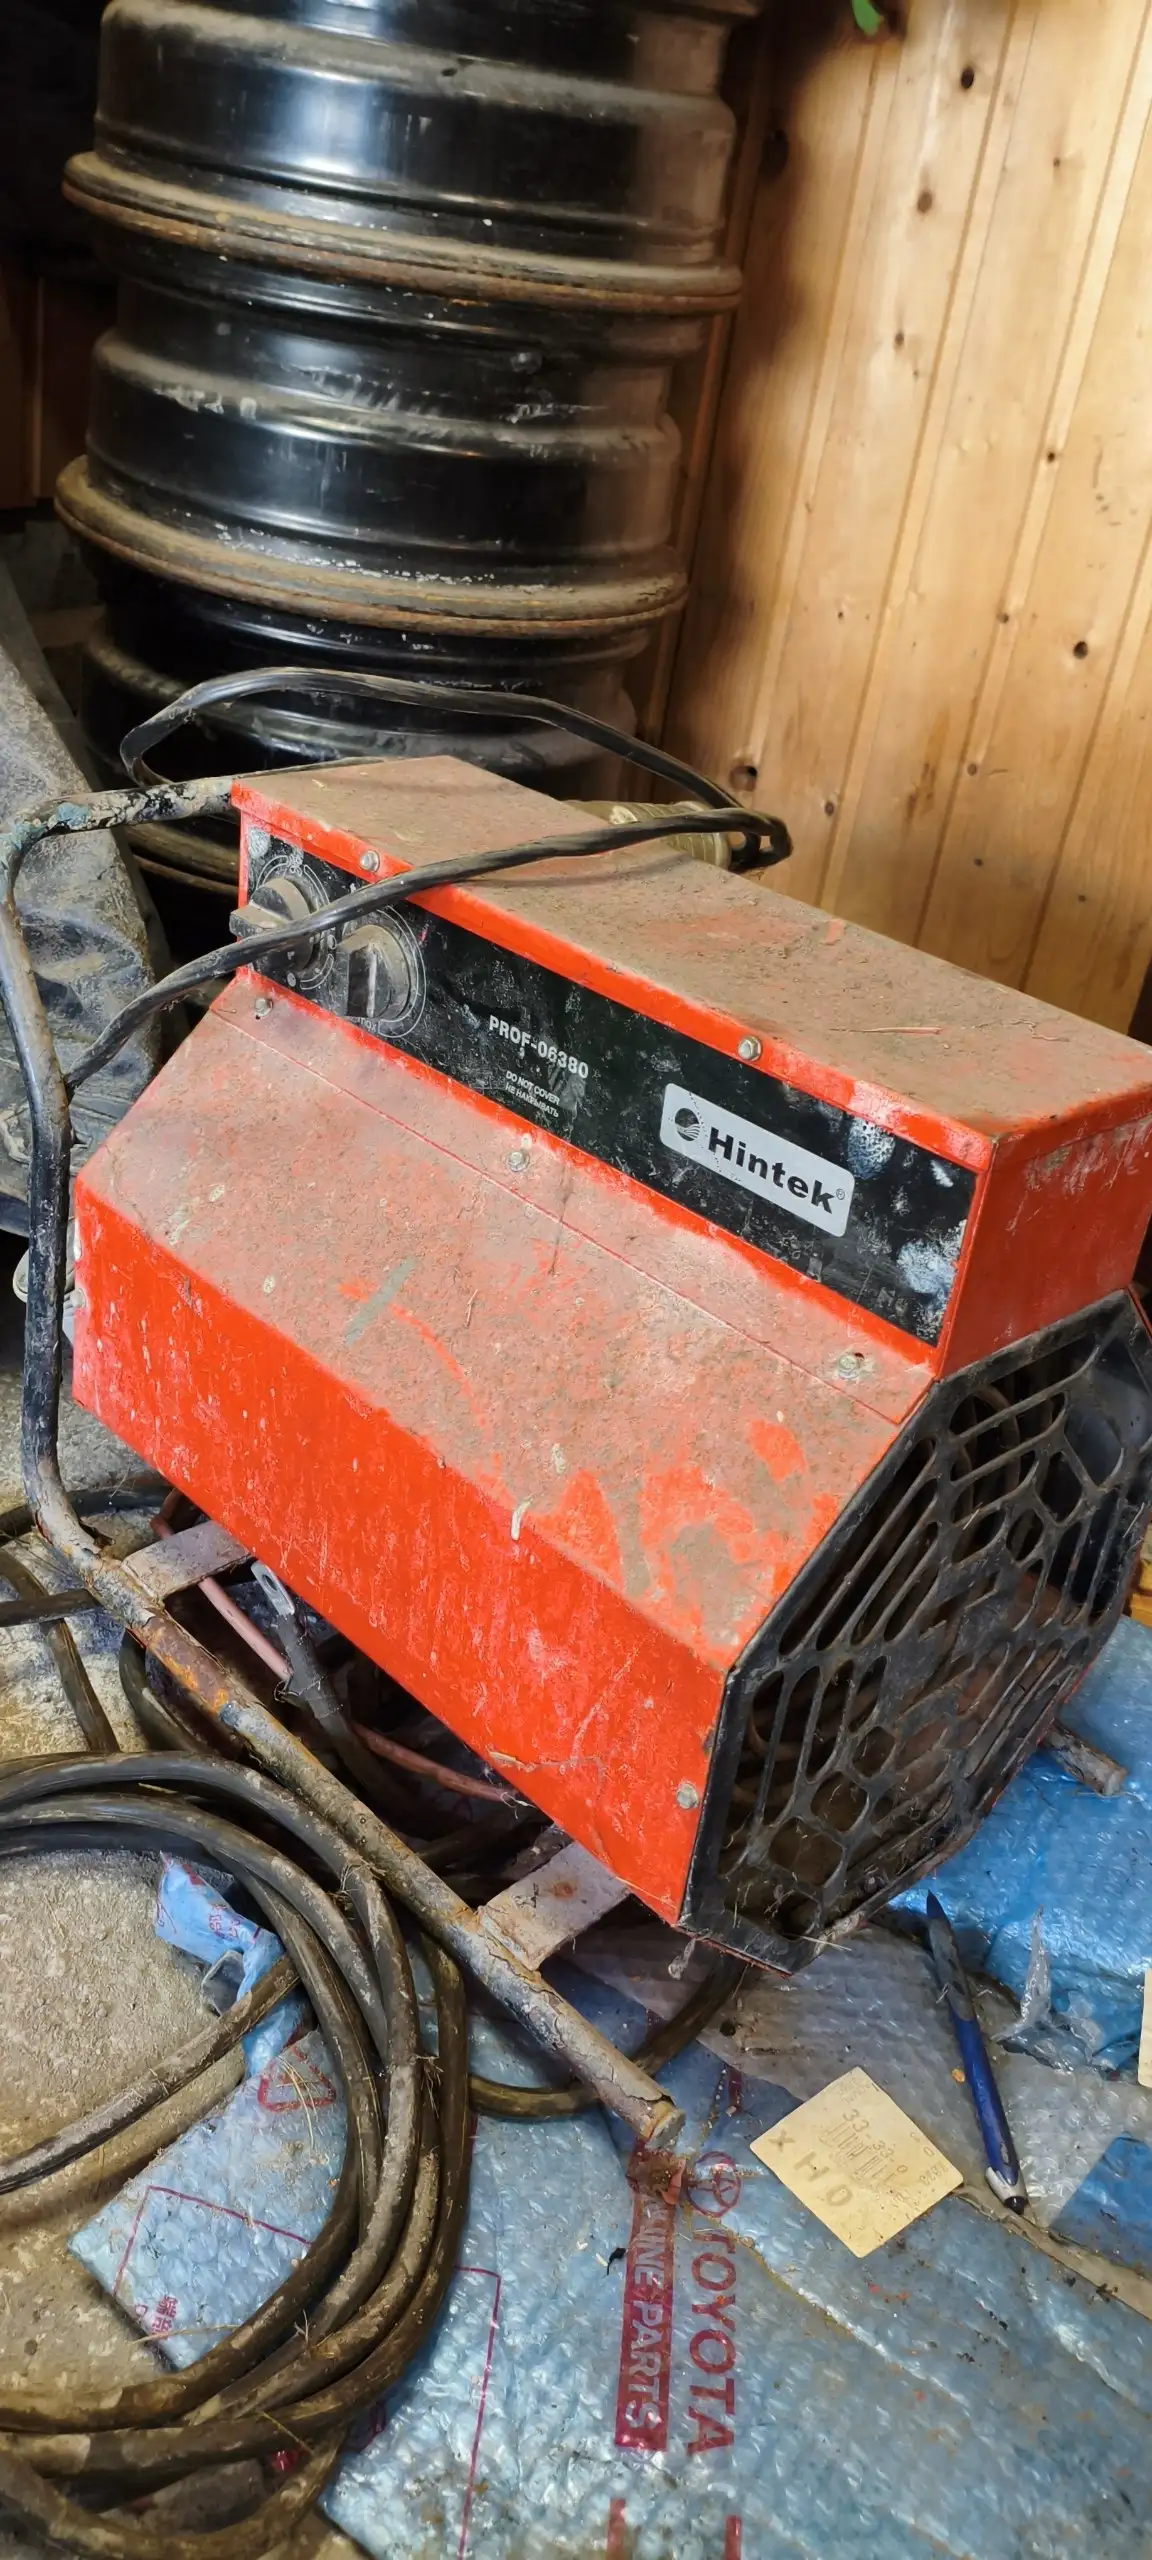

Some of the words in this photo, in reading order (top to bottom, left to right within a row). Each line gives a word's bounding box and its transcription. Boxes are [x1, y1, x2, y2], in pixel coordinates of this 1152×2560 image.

[489, 1015, 588, 1078] PROF-06380
[506, 1070, 517, 1082] DO
[518, 1077, 534, 1091] NOT
[534, 1087, 560, 1105] COVER
[708, 1126, 834, 1215] Hintek
[625, 2300, 663, 2429] PARTS
[688, 2229, 737, 2456] TOYOTA
